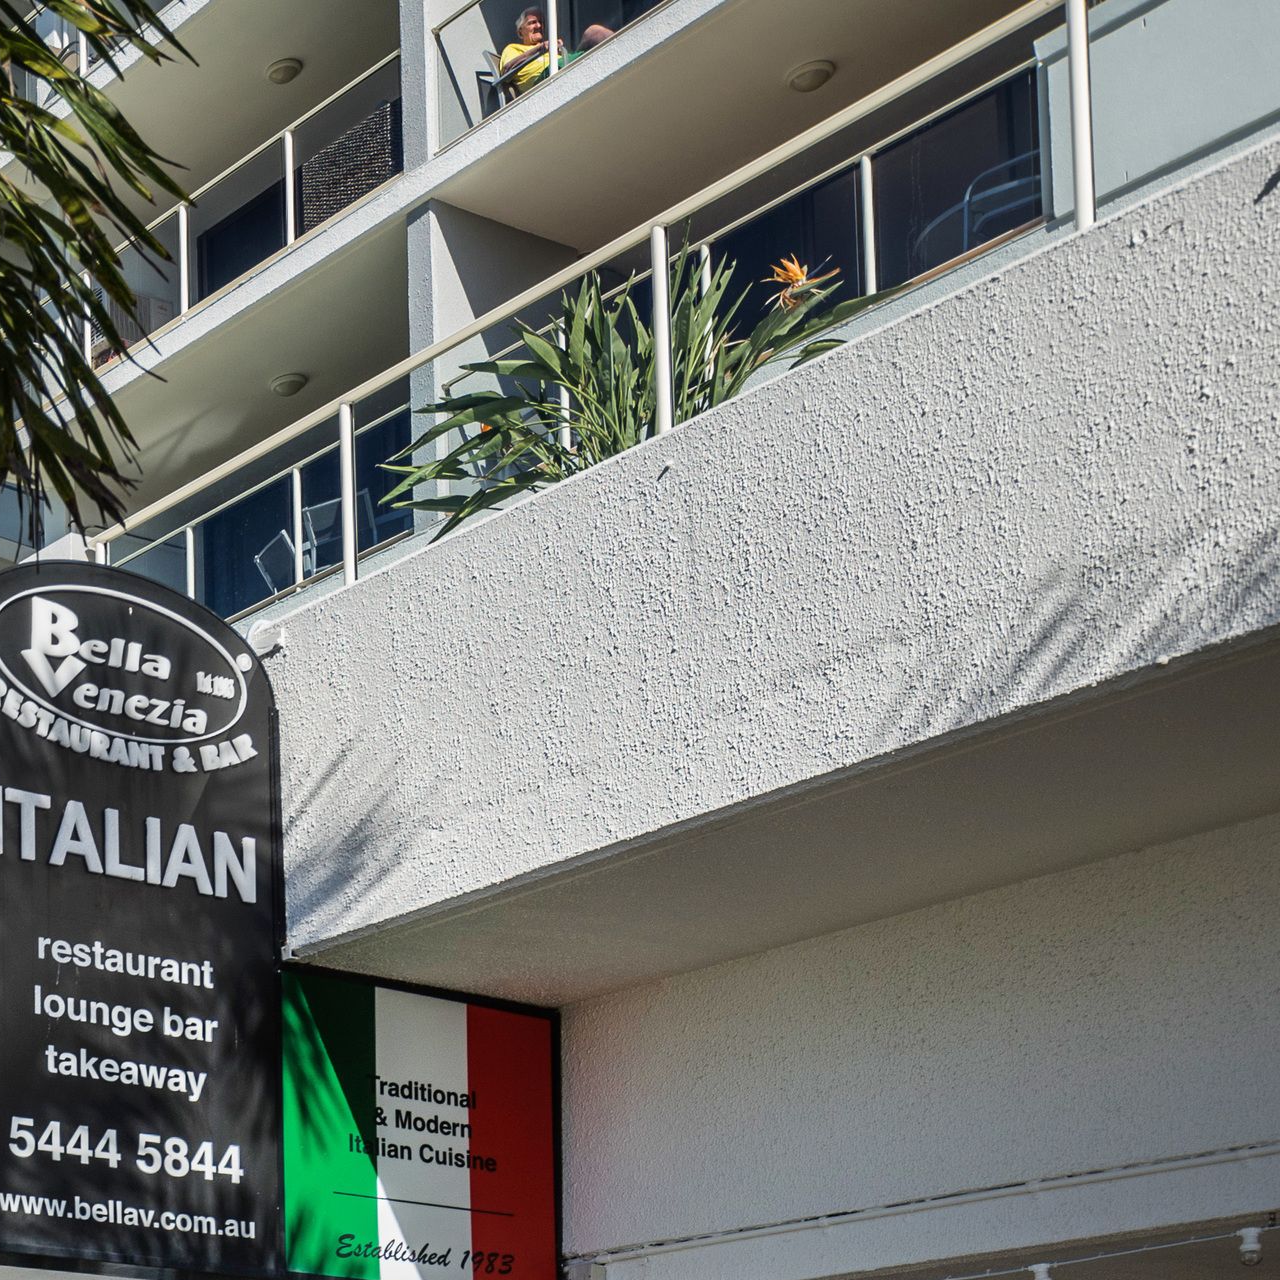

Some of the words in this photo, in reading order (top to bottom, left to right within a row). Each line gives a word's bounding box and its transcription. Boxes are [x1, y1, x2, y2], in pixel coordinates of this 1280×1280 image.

[31, 596, 171, 680] Bella
[21, 650, 207, 735] Venezia
[172, 746, 198, 773] &
[199, 734, 258, 772] BAR
[38, 936, 214, 990] restaurant
[33, 985, 152, 1041] lounge
[163, 1006, 218, 1044] bar
[46, 1044, 207, 1102] takeaway
[366, 1075, 477, 1110] Traditional
[374, 1107, 388, 1128] &
[395, 1108, 473, 1140] Modern
[9, 1116, 121, 1170] 5444
[136, 1134, 244, 1184] 5844
[349, 1134, 412, 1164] Italian
[419, 1140, 497, 1174] Cuisine
[0, 1192, 256, 1241] www.bellav.com.au
[336, 1233, 452, 1271] Established
[460, 1249, 514, 1276] 1983
